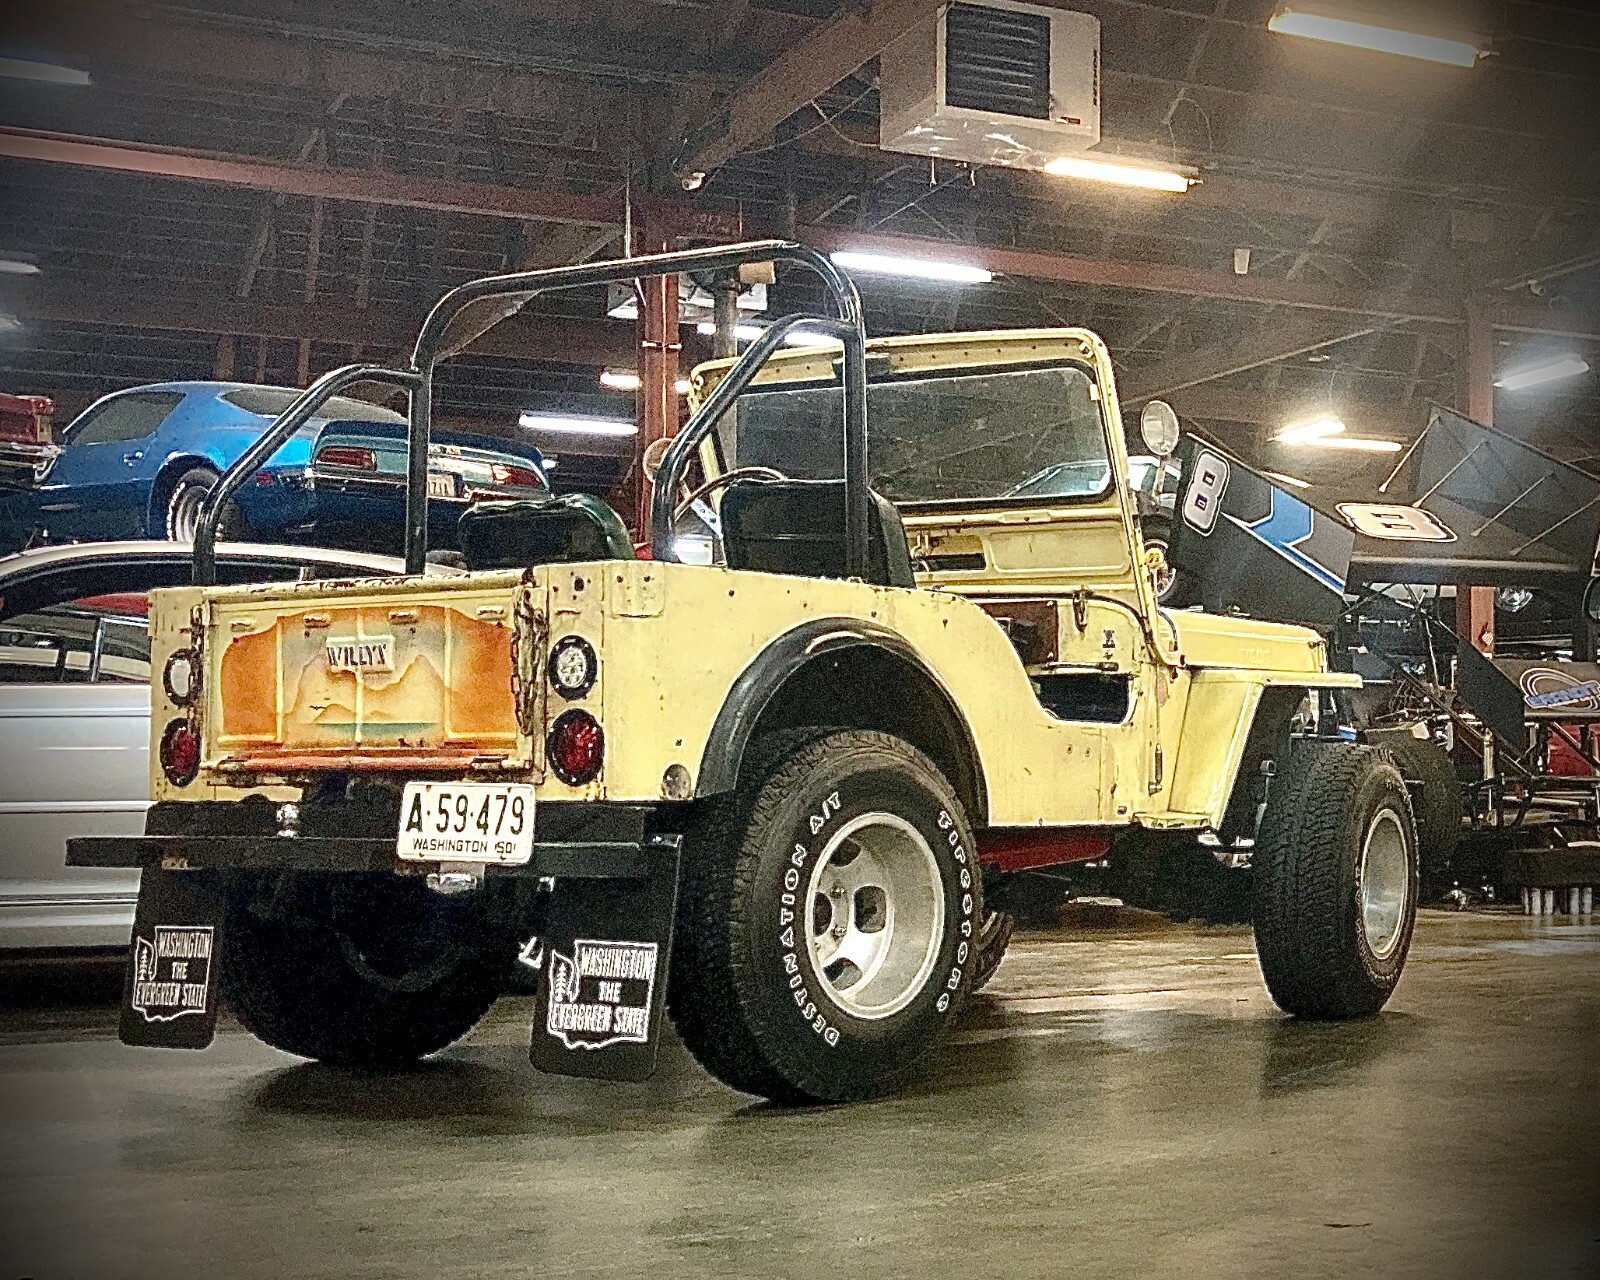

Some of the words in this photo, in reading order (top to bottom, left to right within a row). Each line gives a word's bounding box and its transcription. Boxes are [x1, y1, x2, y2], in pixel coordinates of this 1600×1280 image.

[1183, 449, 1230, 535] 8
[809, 791, 840, 834] A/T
[413, 838, 489, 853] WASHINGTON
[158, 932, 211, 958] WASHINGTON
[780, 843, 840, 1046] DESTINATION
[171, 961, 189, 980] THE
[580, 946, 655, 980] WASHINGTON
[135, 982, 181, 1006] EVERGREEN
[181, 983, 205, 1007] STATE
[598, 980, 622, 1003] THE
[551, 1003, 613, 1032] EVERGREEN
[613, 1006, 648, 1036] STATE
